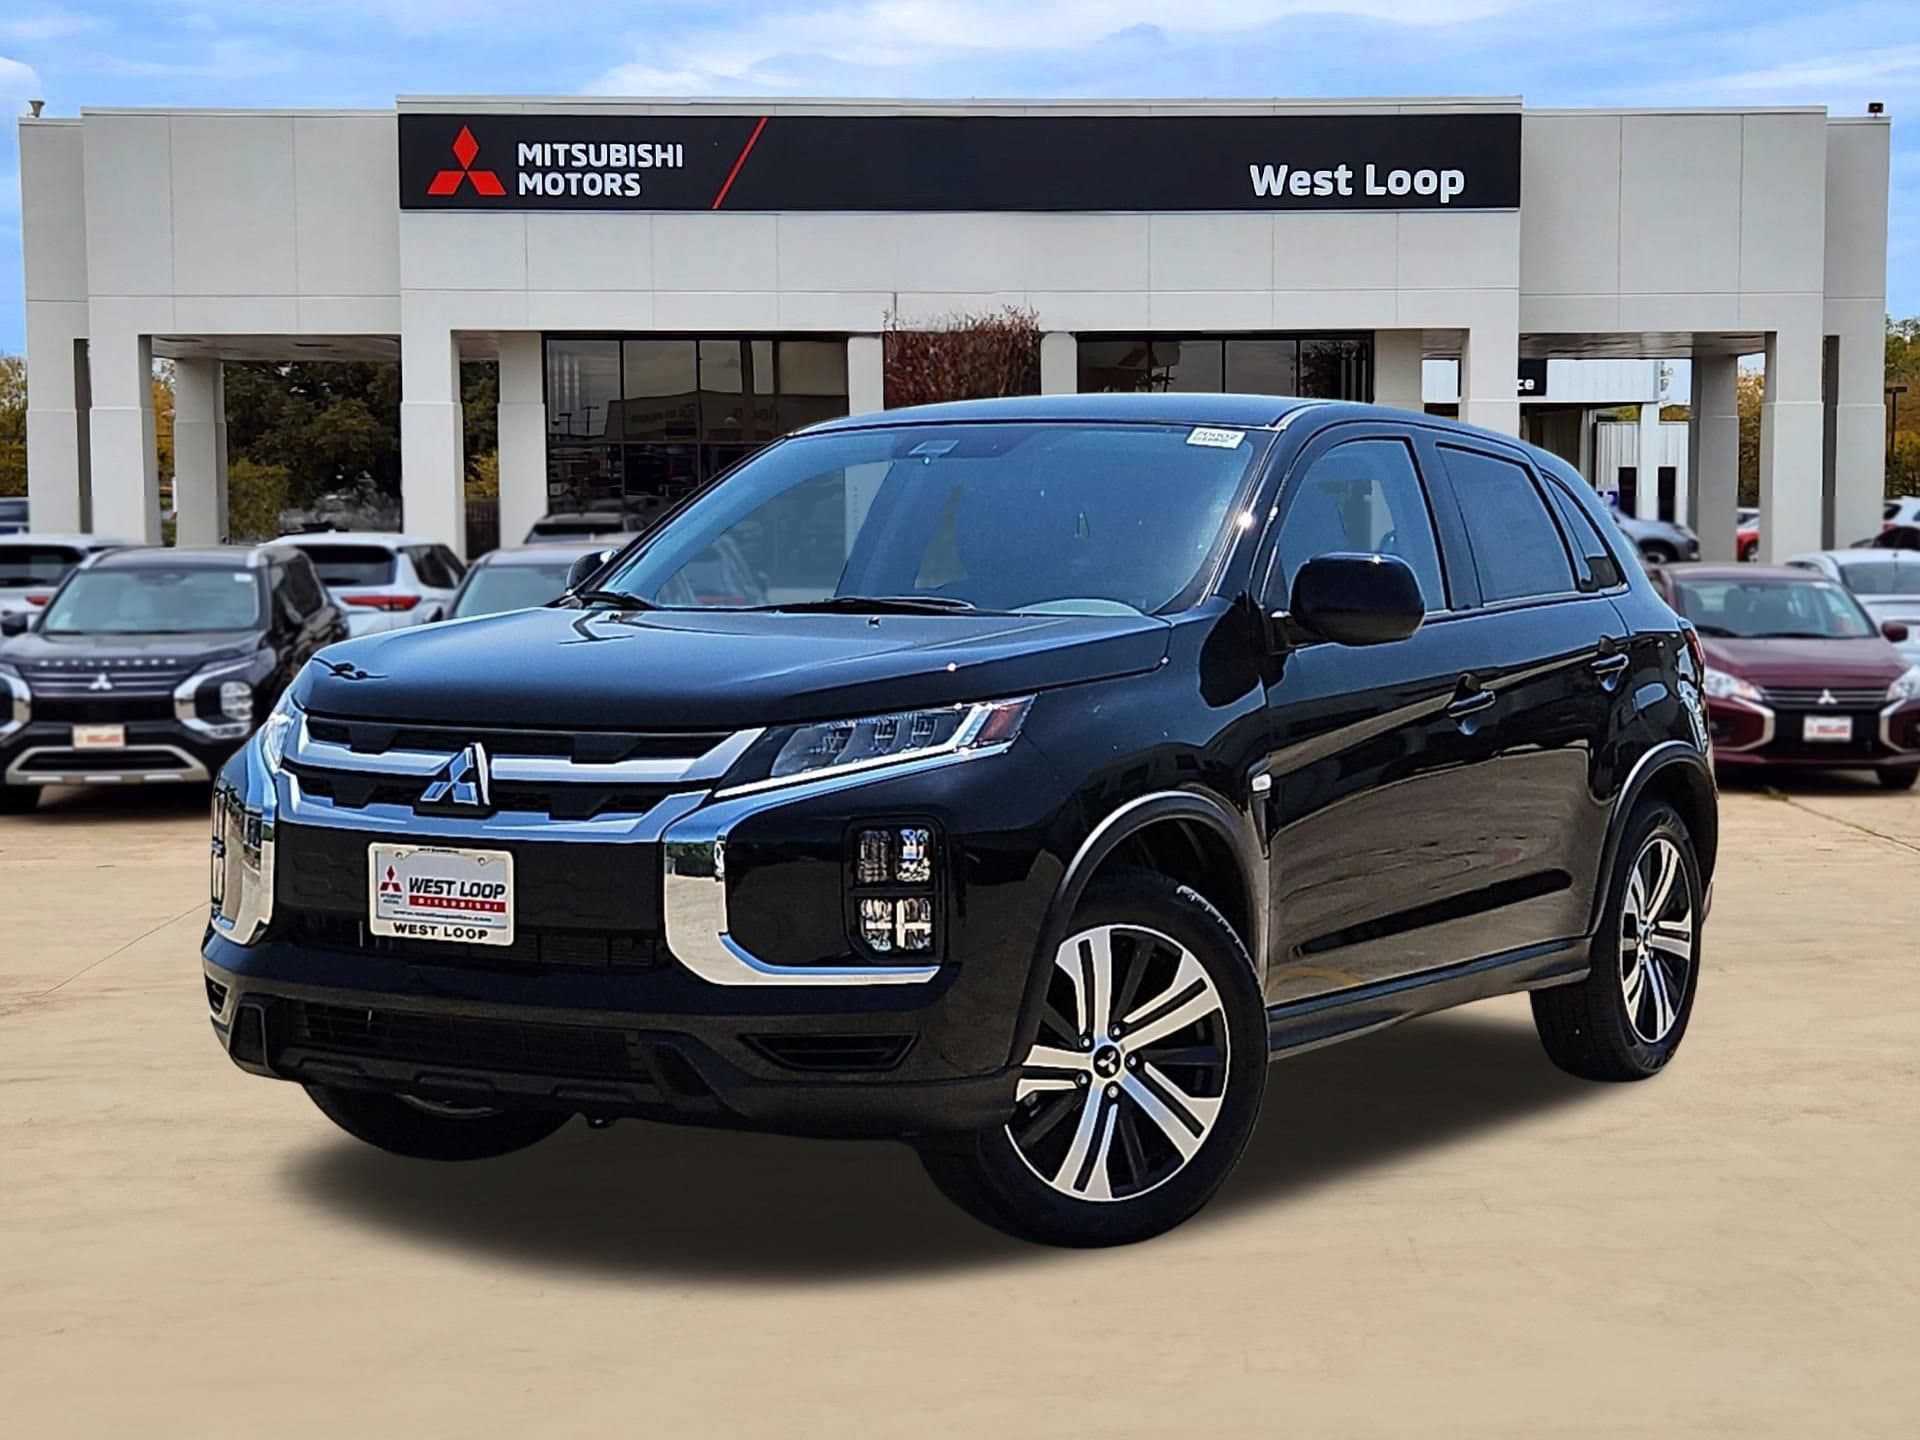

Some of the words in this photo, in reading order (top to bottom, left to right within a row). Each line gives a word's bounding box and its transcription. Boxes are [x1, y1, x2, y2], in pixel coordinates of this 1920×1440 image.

[517, 143, 684, 168] MITSUBISHI
[517, 172, 641, 197] MOTORS
[1249, 164, 1353, 197] West
[1365, 164, 1465, 204] Loop
[408, 877, 456, 897] WEST
[459, 881, 506, 899] LOOP
[393, 922, 438, 937] WEST
[444, 926, 489, 940] LOOP
